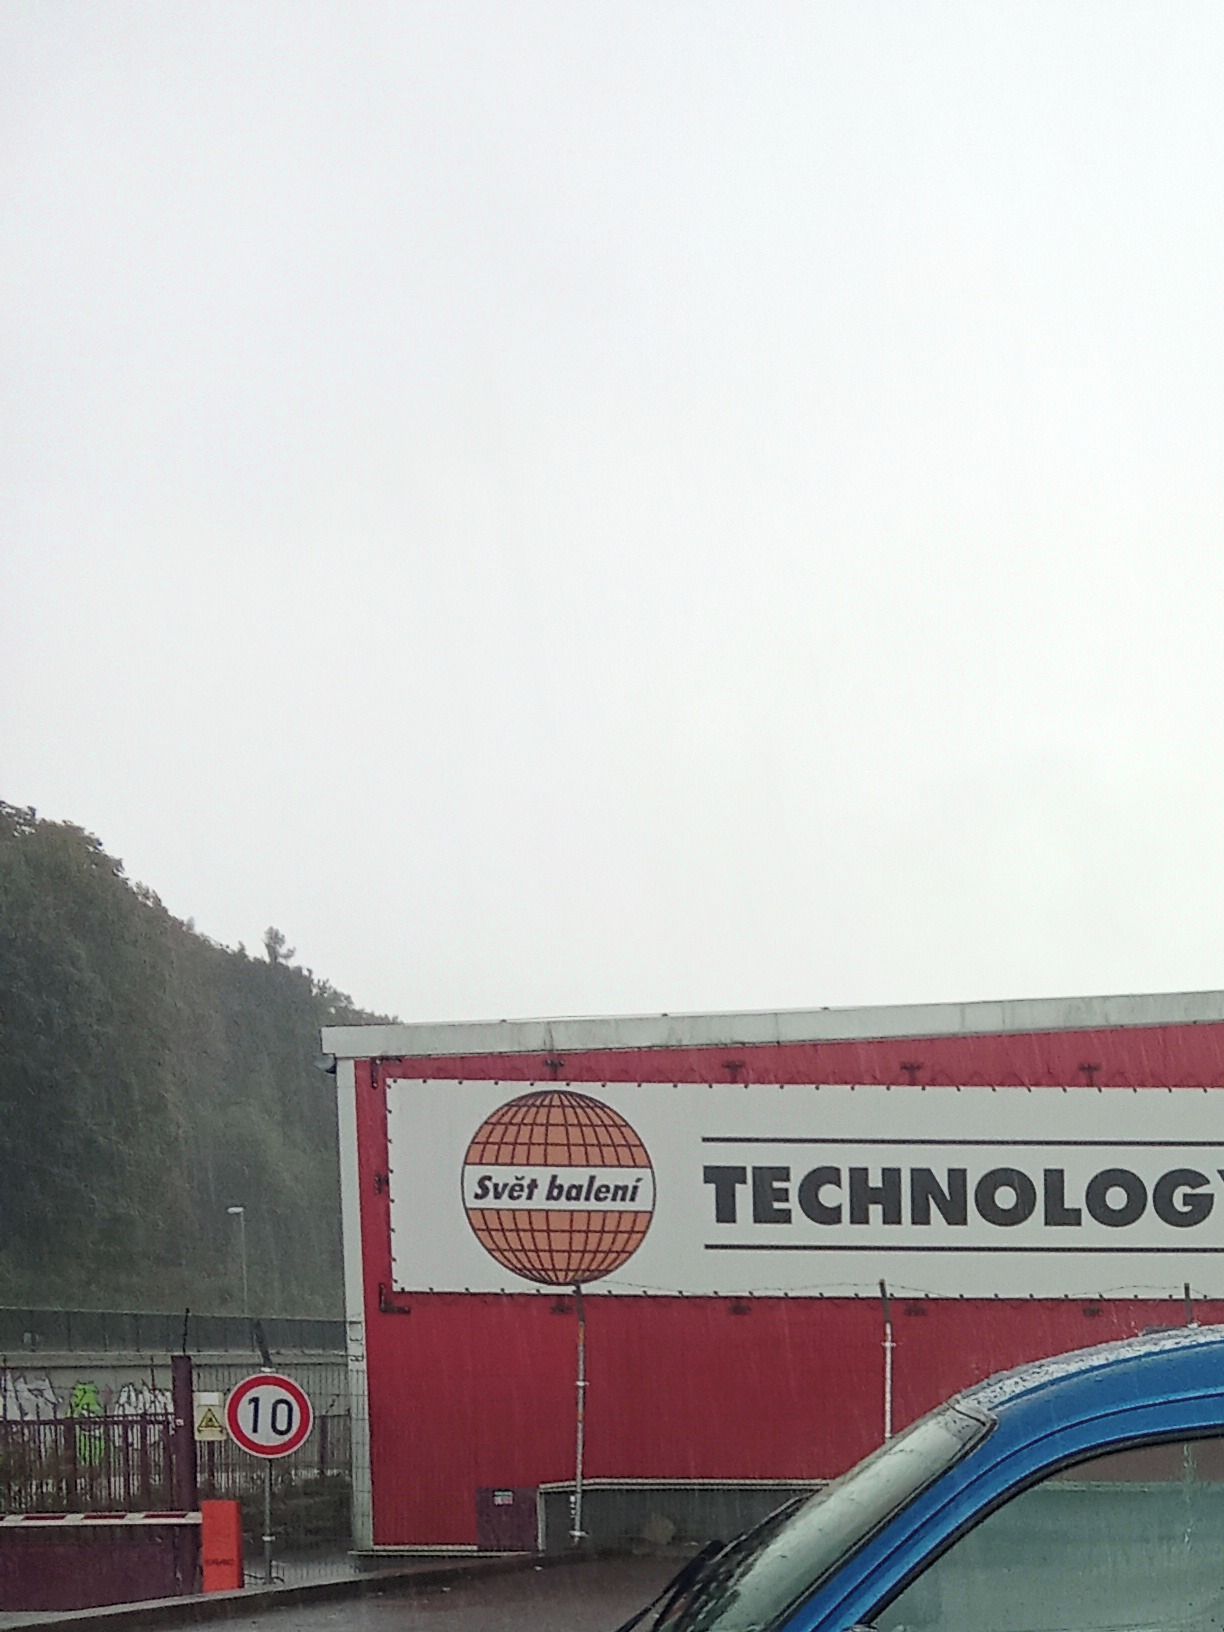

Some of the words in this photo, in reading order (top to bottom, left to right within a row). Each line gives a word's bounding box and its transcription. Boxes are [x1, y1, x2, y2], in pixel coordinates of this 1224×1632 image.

[473, 1174, 539, 1201] Svět
[545, 1173, 644, 1203] balení
[246, 1396, 294, 1437] 10
